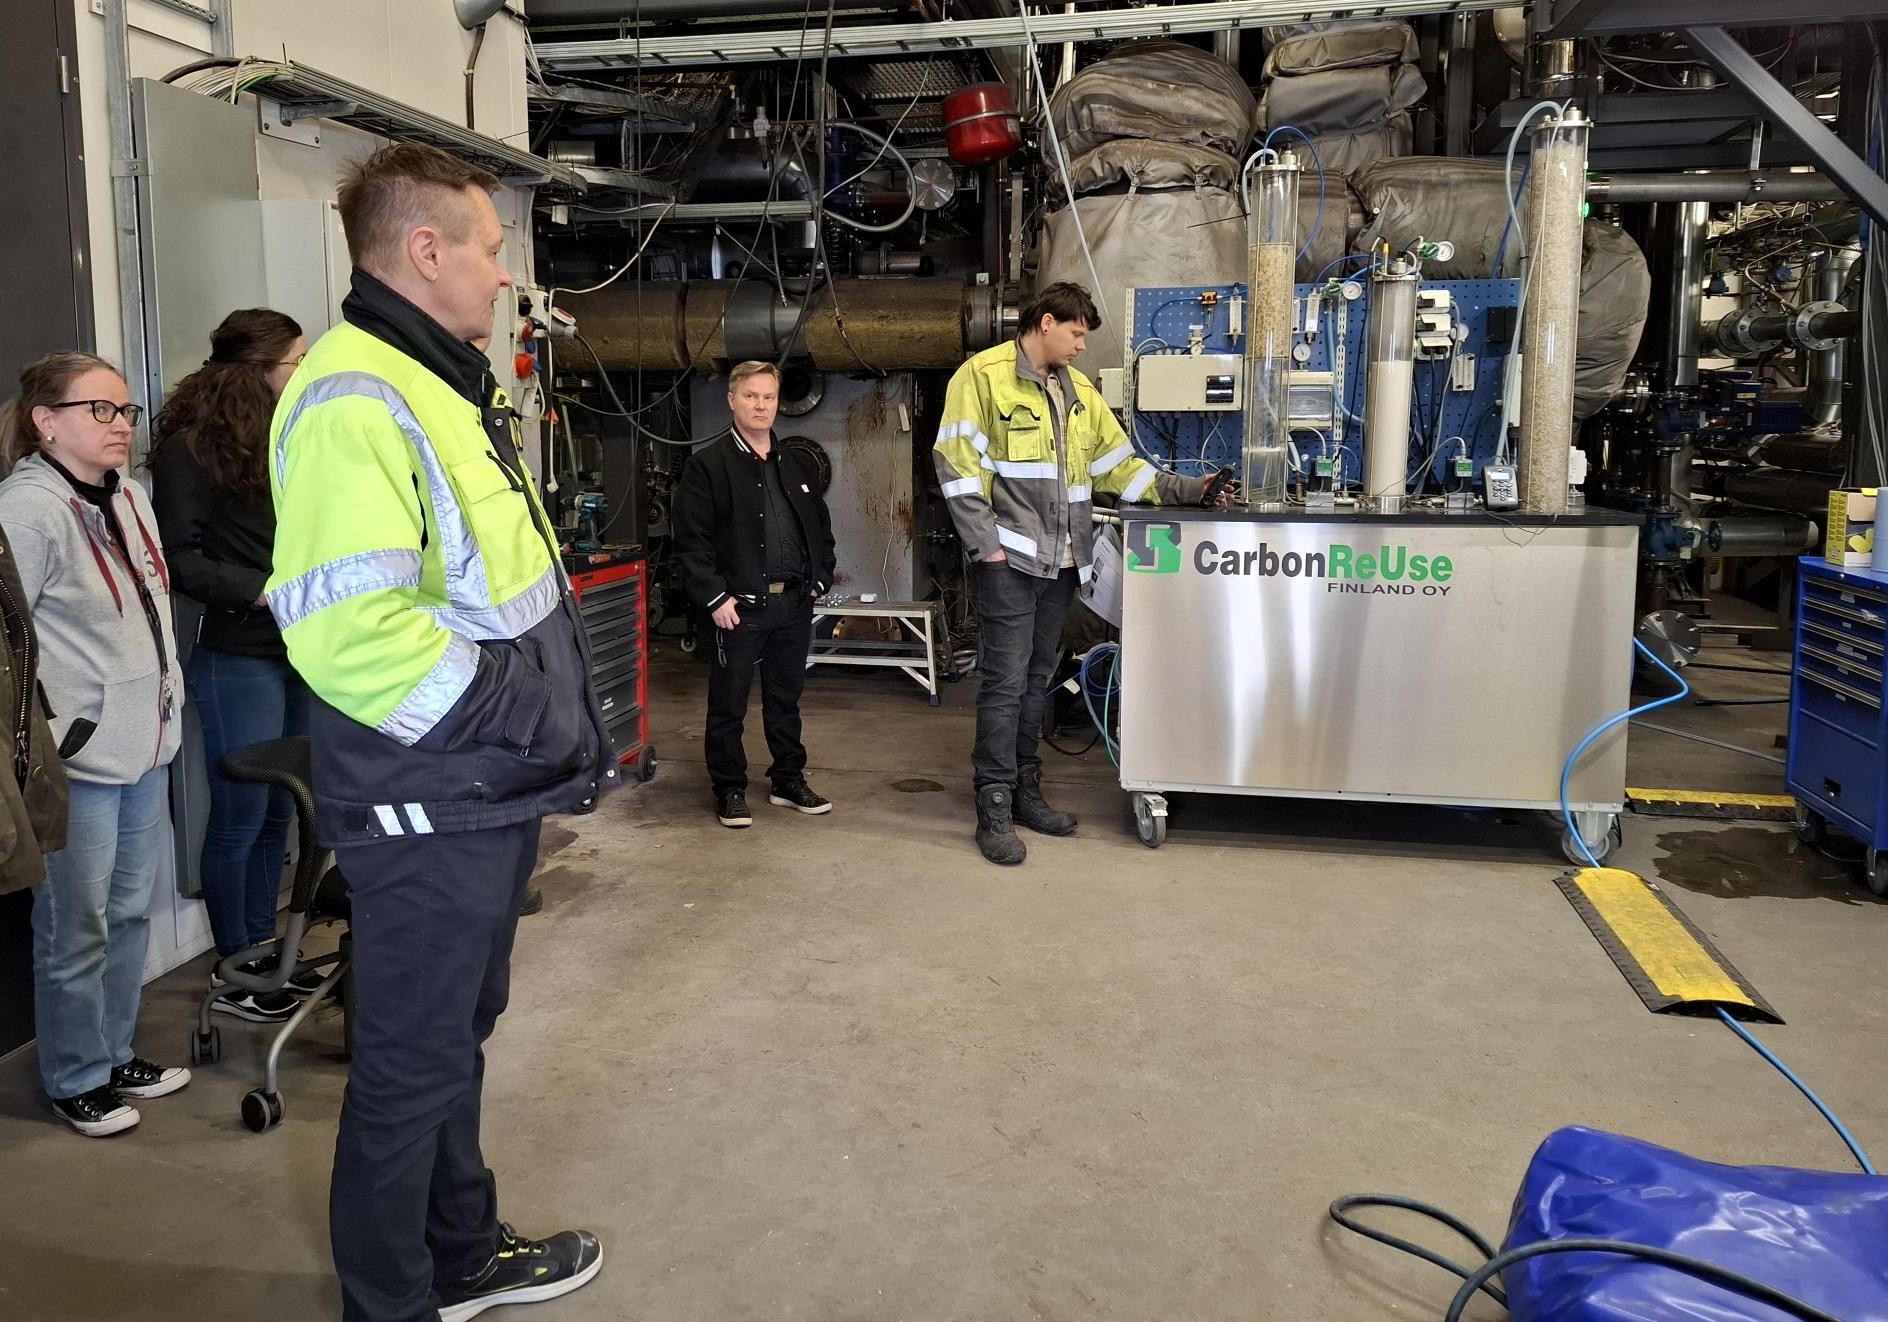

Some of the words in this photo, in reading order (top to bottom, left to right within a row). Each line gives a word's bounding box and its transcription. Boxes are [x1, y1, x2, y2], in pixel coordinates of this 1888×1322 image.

[1193, 540, 1453, 582] CarbonReUse
[1328, 583, 1415, 595] FINLAND
[1422, 585, 1452, 596] OY
